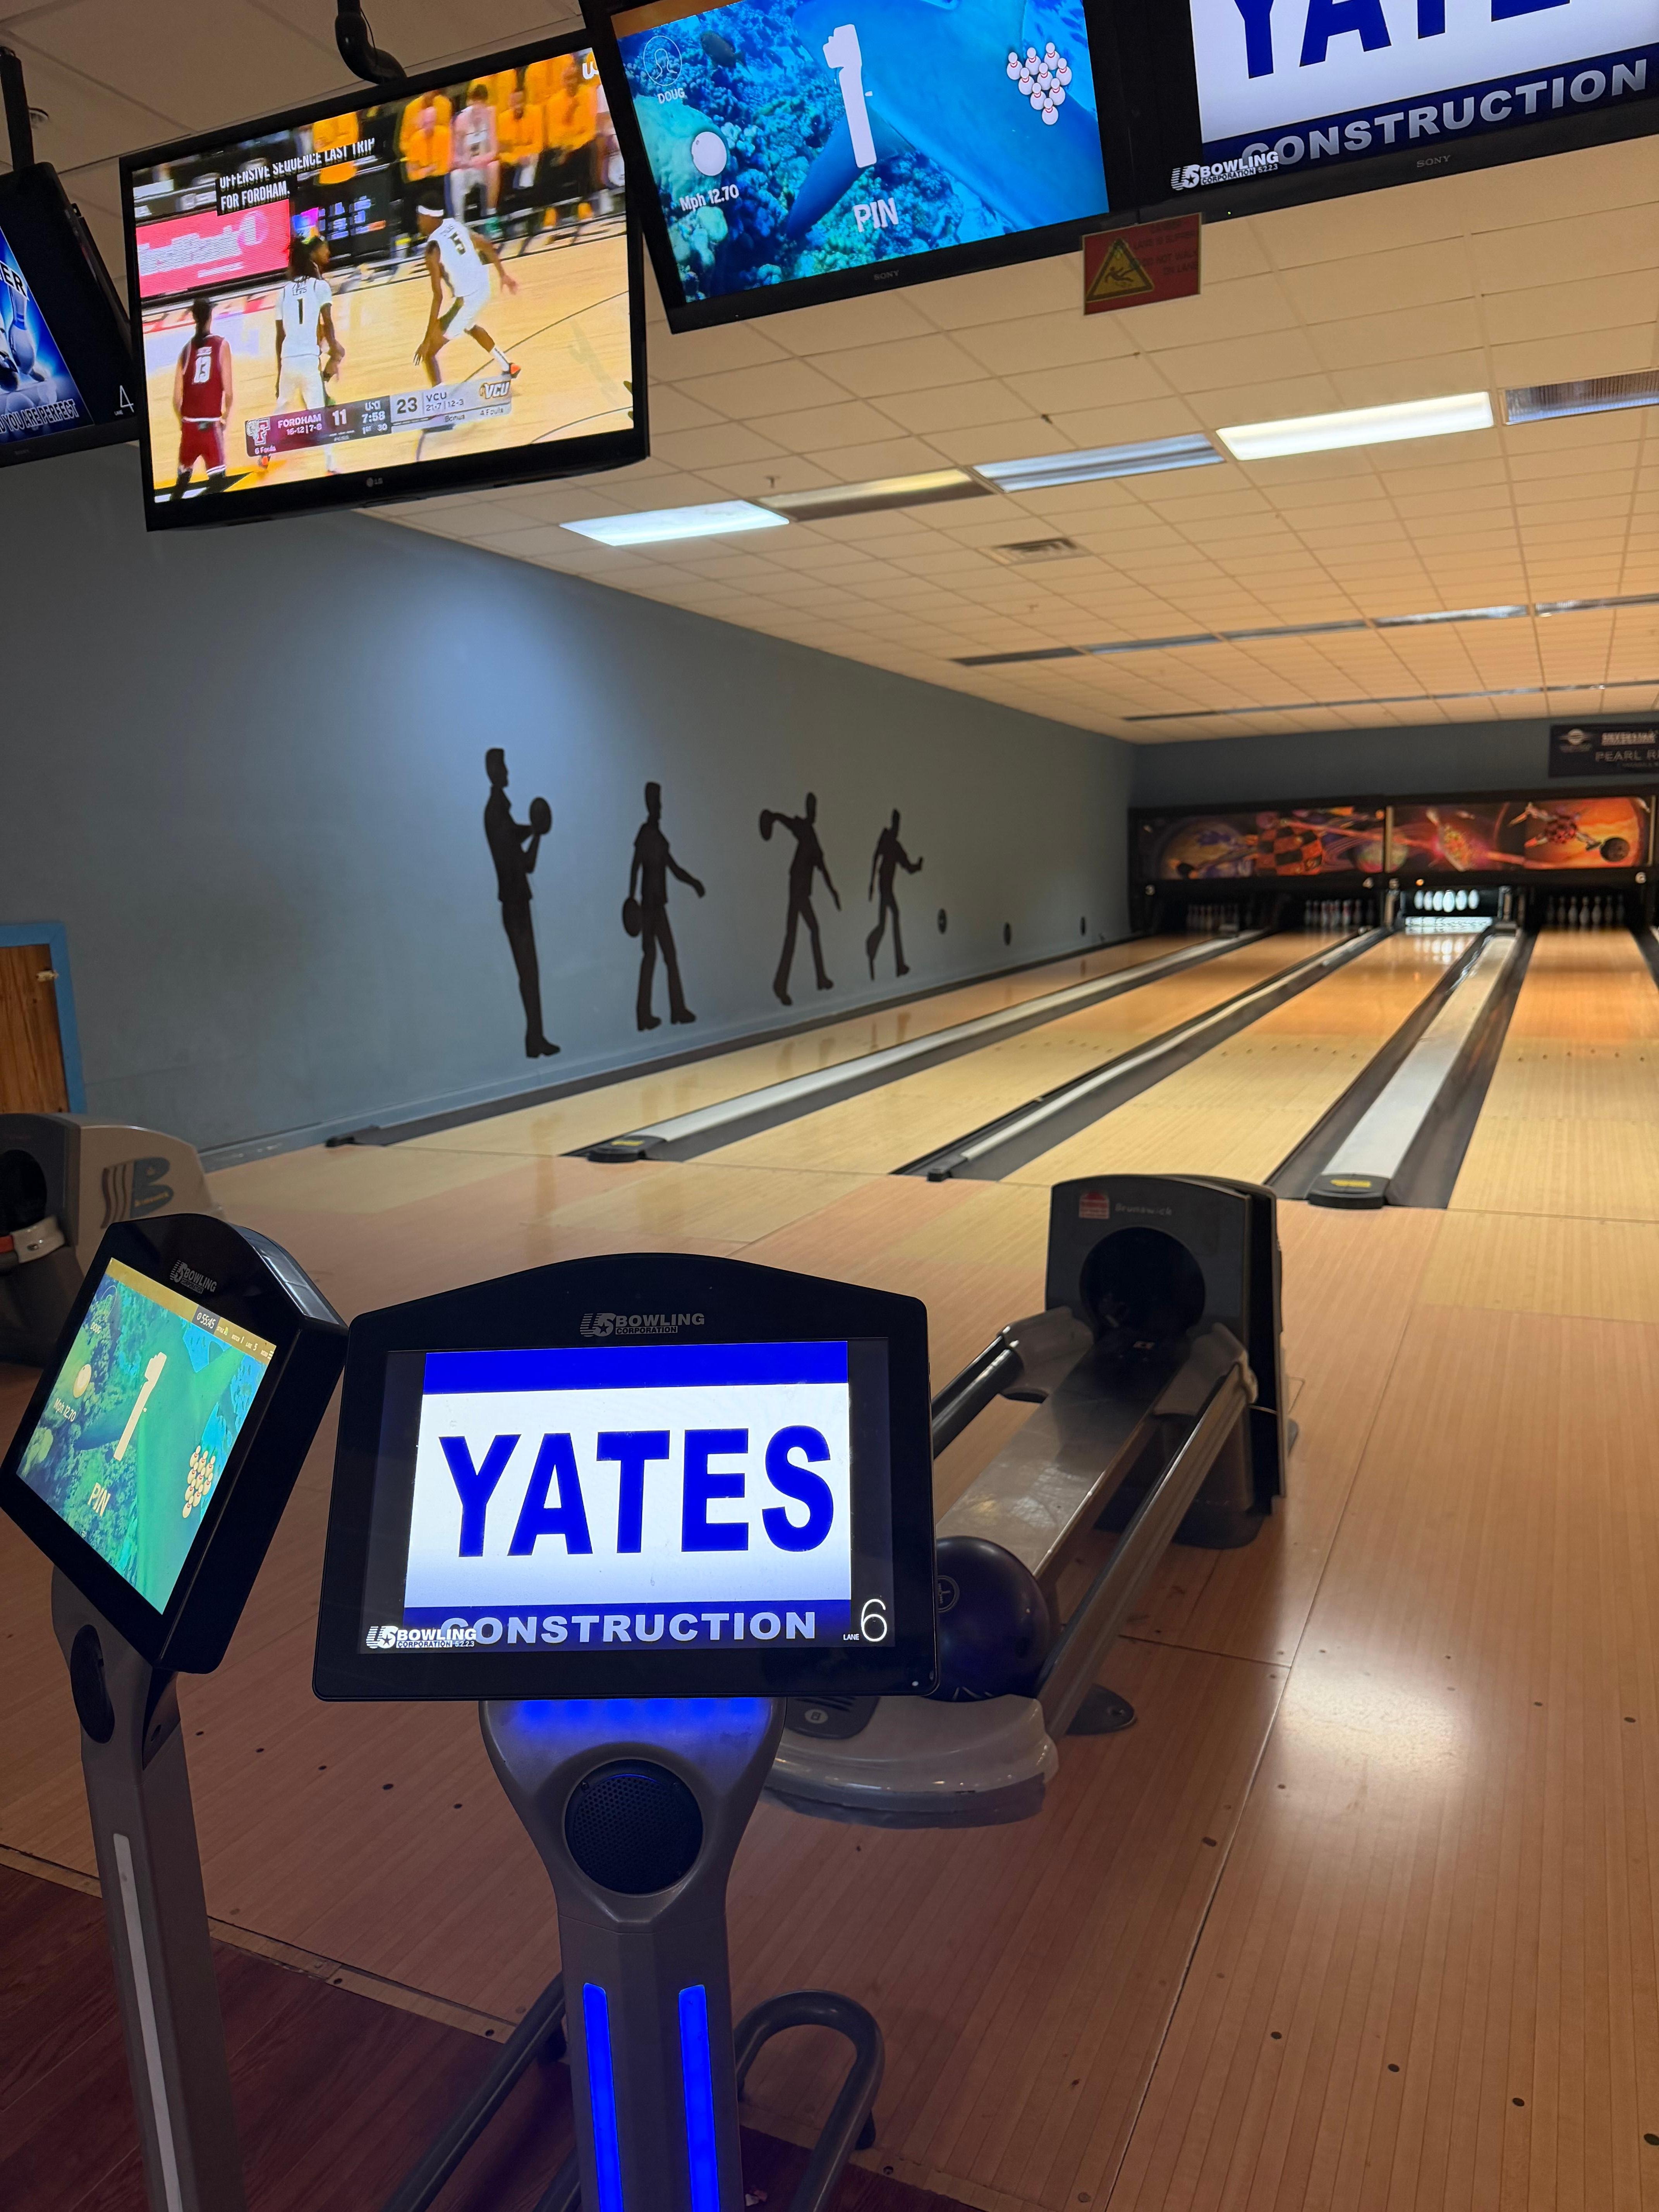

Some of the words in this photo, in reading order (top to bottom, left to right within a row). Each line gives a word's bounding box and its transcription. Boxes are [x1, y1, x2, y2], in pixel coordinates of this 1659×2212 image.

[657, 88, 685, 104] DOUG
[220, 167, 270, 192] OFFENSIVE
[272, 153, 322, 179] SEQUENCE
[324, 146, 347, 165] LAST
[352, 137, 375, 158] TRIP
[1201, 151, 1279, 177] BOWLING
[1417, 155, 1451, 168] SONY
[1201, 167, 1256, 185] CORPORATION
[220, 192, 239, 213] FOR
[241, 180, 290, 206] FORDHAM.
[679, 193, 706, 211] Mph
[708, 184, 739, 204] 12.70
[853, 197, 899, 232] PIN
[874, 270, 899, 281] SONY
[297, 298, 303, 325] 1
[120, 385, 134, 413] 4
[396, 397, 418, 414] 23
[426, 392, 447, 402] VCU
[2, 412, 25, 431] YOU
[22, 408, 44, 428] ARE
[38, 399, 79, 424] PERFECT
[277, 413, 322, 428] FORDHAM
[332, 409, 347, 426] 11
[361, 410, 386, 424] 7:58
[1595, 750, 1642, 762] PEARL
[184, 1267, 217, 1292] BOWLING
[90, 1322, 102, 1334] DOUG
[616, 1313, 705, 1327] BOWLING
[200, 1314, 216, 1329] 55:45
[253, 1343, 258, 1351] 5
[616, 1326, 678, 1335] CORPORATION
[53, 1398, 65, 1413] Mph
[64, 1405, 77, 1422] 12.70
[87, 1482, 111, 1518] PIN
[438, 1425, 834, 1558] YATES
[861, 1599, 887, 1642] 6
[397, 1628, 476, 1641] BOWLING
[396, 1640, 453, 1649] CORPORATION
